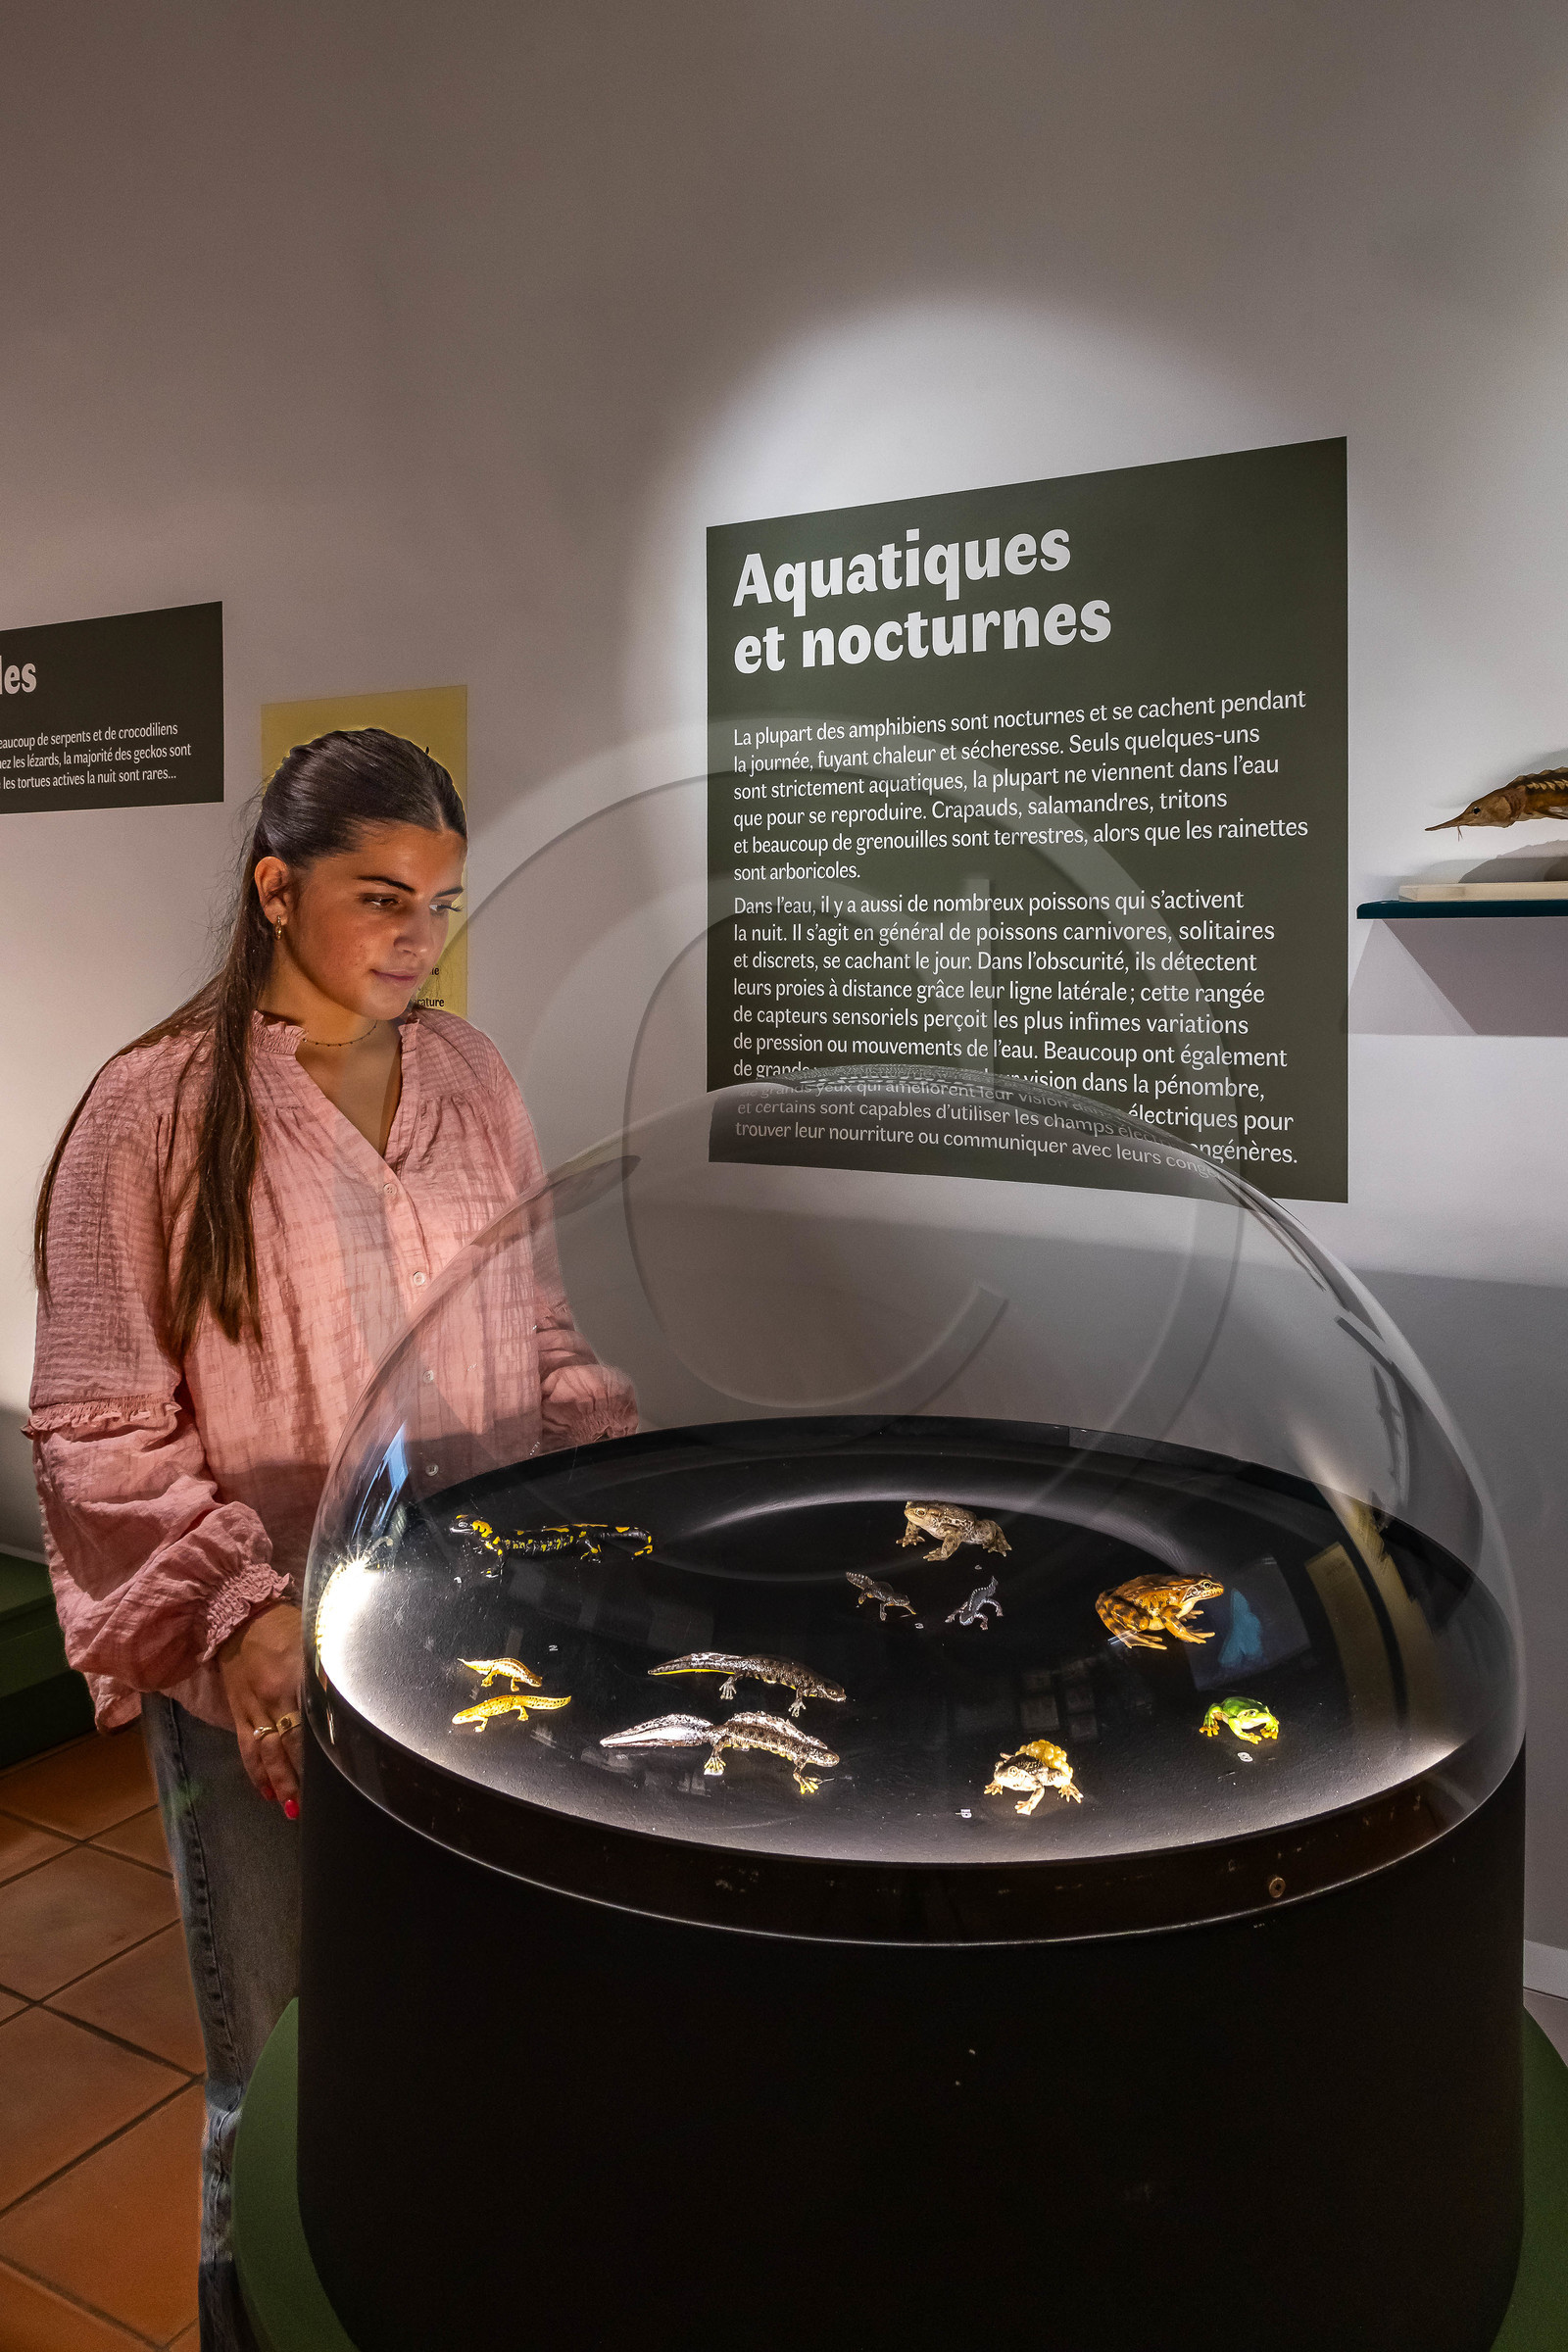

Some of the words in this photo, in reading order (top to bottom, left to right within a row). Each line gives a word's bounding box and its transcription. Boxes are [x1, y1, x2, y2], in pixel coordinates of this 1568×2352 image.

[732, 528, 1071, 617] Aquatiques
[734, 625, 786, 674] et
[803, 599, 1111, 668] nocturnes
[36, 732, 49, 747] de
[50, 730, 91, 748] serpents
[92, 728, 103, 742] et
[104, 725, 117, 741] de
[118, 721, 178, 740] crocodiliens
[734, 728, 752, 746] La
[756, 725, 813, 750] plupart
[816, 721, 846, 741] des
[849, 715, 947, 743] amphibiens
[950, 713, 990, 732] sont
[994, 709, 1085, 729] nocturnes
[1089, 705, 1108, 722] et
[1112, 706, 1134, 720] se
[1138, 696, 1216, 719] cachent
[1221, 689, 1307, 719] pendant
[13, 755, 25, 768] les
[26, 752, 62, 768] lézards,
[63, 751, 73, 765] la
[74, 746, 114, 767] majorité
[114, 747, 132, 761] des
[132, 744, 168, 764] geckos
[169, 743, 192, 758] sont
[734, 755, 747, 773] la
[749, 750, 813, 778] journée,
[816, 750, 869, 773] fuyant
[872, 745, 937, 765] chaleur
[940, 744, 957, 761] et
[960, 739, 1064, 760] sécheresse.
[1069, 731, 1120, 754] Seuls
[1124, 728, 1260, 756] quelques-uns
[3, 776, 16, 790] les
[17, 776, 51, 789] tortues
[52, 771, 85, 787] actives
[86, 770, 96, 785] la
[97, 768, 117, 784] nuit
[118, 768, 140, 783] sont
[142, 768, 176, 781] rares...
[733, 783, 767, 801] sont
[770, 778, 865, 799] strictement
[868, 772, 967, 799] aquatiques,
[973, 769, 988, 789] la
[993, 767, 1059, 794] plupart
[1064, 768, 1087, 784] ne
[1091, 761, 1175, 782] viennent
[1179, 758, 1228, 778] dans
[1234, 755, 1279, 775] l’eau
[733, 812, 762, 832] que
[766, 811, 806, 831] pour
[808, 810, 827, 824] se
[831, 802, 927, 828] reproduire.
[931, 797, 1022, 823] Crapauds,
[1027, 792, 1154, 815] salamandres,
[1158, 789, 1228, 809] tritons
[733, 838, 749, 855] et
[753, 835, 829, 858] beaucoup
[832, 832, 853, 852] de
[856, 829, 948, 856] grenouilles
[952, 830, 991, 848] sont
[993, 827, 1089, 847] terrestres,
[1093, 822, 1140, 843] alors
[1144, 825, 1181, 847] que
[1186, 819, 1213, 840] les
[1218, 817, 1308, 839] rainettes
[733, 865, 767, 881] sont
[769, 860, 860, 880] arboricoles.
[734, 897, 773, 914] Dans
[777, 896, 816, 917] l’eau,
[821, 895, 829, 913] il
[833, 900, 844, 919] y
[847, 900, 857, 913] a
[860, 894, 903, 913] aussi
[907, 894, 929, 912] de
[933, 892, 1024, 912] nombreux
[1029, 891, 1110, 916] poissons
[1115, 895, 1145, 915] qui
[1151, 889, 1245, 909] s’activent
[734, 923, 748, 942] la
[752, 923, 787, 942] nuit.
[793, 923, 802, 941] Il
[806, 922, 850, 947] s’agit
[854, 927, 874, 941] en
[878, 921, 944, 947] général
[949, 921, 971, 941] de
[976, 921, 1057, 947] poissons
[1062, 920, 1172, 945] carnivores,
[1178, 919, 1275, 941] solitaires
[733, 953, 749, 968] et
[752, 951, 818, 972] discrets,
[822, 956, 841, 969] se
[845, 951, 911, 969] cachant
[915, 951, 930, 969] le
[932, 951, 972, 975] jour.
[978, 951, 1023, 970] Dans
[1028, 950, 1129, 975] l’obscurité,
[1135, 951, 1156, 971] ils
[1160, 950, 1257, 971] détectent
[734, 977, 772, 996] leurs
[776, 978, 825, 1002] proies
[828, 977, 839, 997] à
[842, 978, 912, 998] distance
[916, 978, 965, 1004] grâce
[970, 980, 1005, 1000] leur
[1009, 980, 1053, 1005] ligne
[1140, 985, 1190, 1003] cette
[1196, 981, 1265, 1009] rangée
[733, 1004, 753, 1023] de
[757, 1008, 828, 1029] capteurs
[832, 1007, 918, 1027] sensoriels
[923, 1008, 988, 1033] perçoit
[994, 1009, 1018, 1029] les
[1024, 1010, 1063, 1035] plus
[1069, 1010, 1141, 1032] infimes
[1146, 1012, 1249, 1035] variations
[733, 1032, 753, 1050] de
[757, 1033, 823, 1055] pression
[827, 1039, 848, 1053] ou
[852, 1040, 962, 1056] mouvements
[966, 1038, 989, 1057] de
[994, 1039, 1038, 1059] l’eau.
[1044, 1041, 1138, 1068] Beaucoup
[1142, 1047, 1176, 1064] ont
[1180, 1043, 1288, 1071] également
[733, 1059, 753, 1077] de
[1082, 1071, 1128, 1093] dans
[1133, 1073, 1150, 1095] la
[1154, 1073, 1265, 1102] pénombre,
[755, 1100, 816, 1115] certains
[819, 1101, 856, 1115] sont
[859, 1101, 932, 1121] capables
[936, 1103, 1010, 1124] d’utiliser
[1014, 1108, 1040, 1126] les
[1044, 1113, 1114, 1138] champs
[1244, 1113, 1295, 1136] pour
[735, 1121, 792, 1138] trouver
[795, 1122, 826, 1140] leur
[829, 1125, 914, 1145] nourriture
[918, 1131, 939, 1146] ou
[944, 1133, 1068, 1157] communiquer
[1071, 1143, 1112, 1158] avec
[1115, 1143, 1162, 1165] leurs
